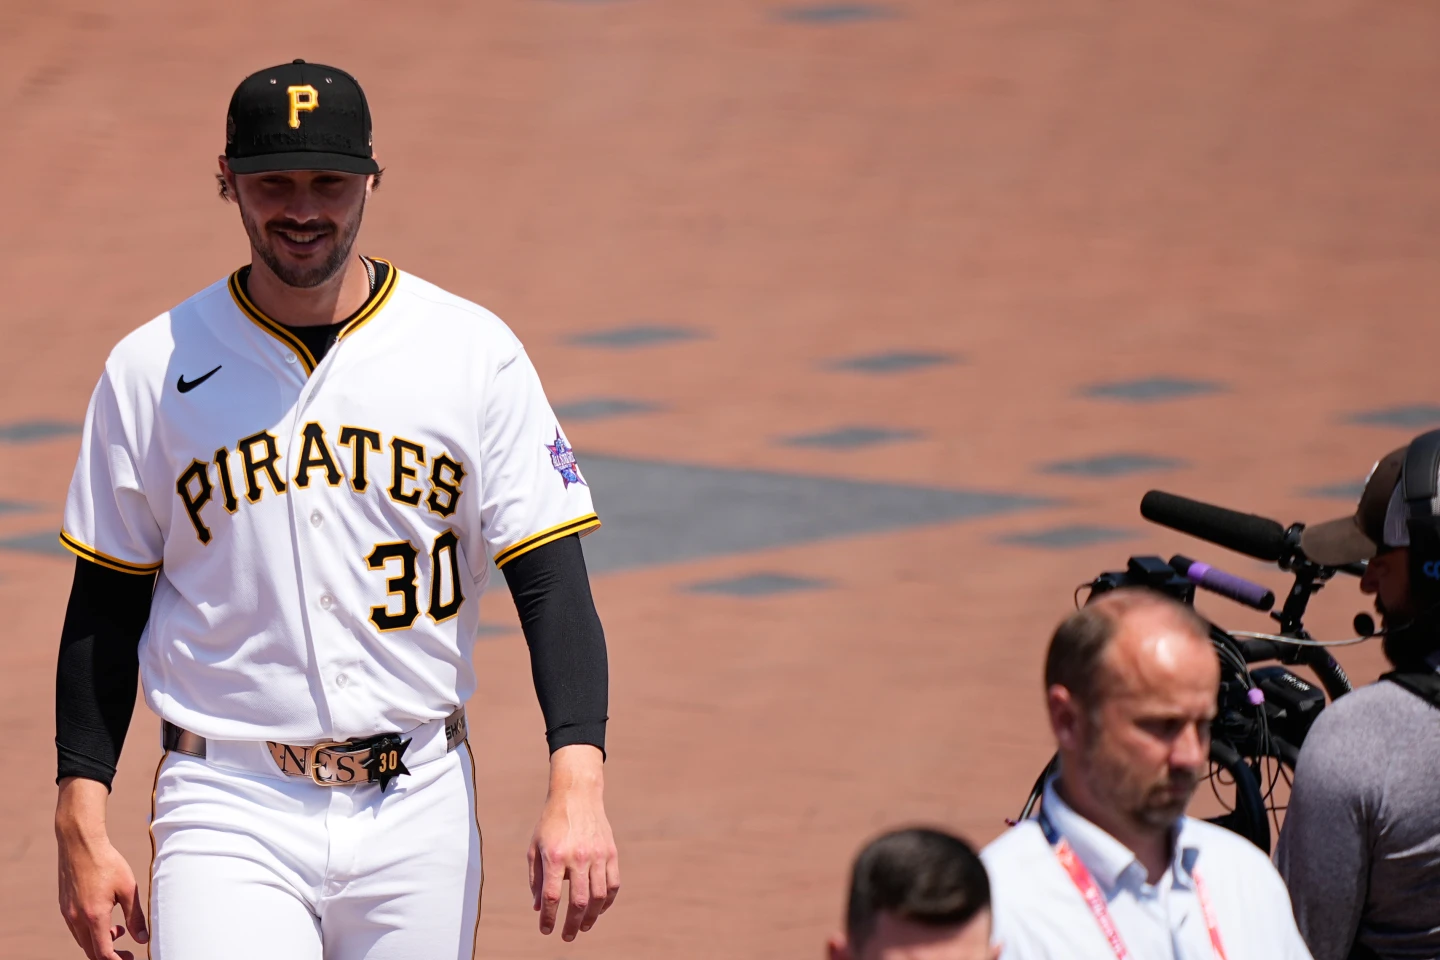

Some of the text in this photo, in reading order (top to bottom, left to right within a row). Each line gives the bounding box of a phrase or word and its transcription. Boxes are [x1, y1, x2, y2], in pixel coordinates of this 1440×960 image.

[286, 84, 319, 129] P
[176, 420, 468, 547] PIRATES
[364, 527, 466, 633] 30
[379, 750, 398, 773] 30
